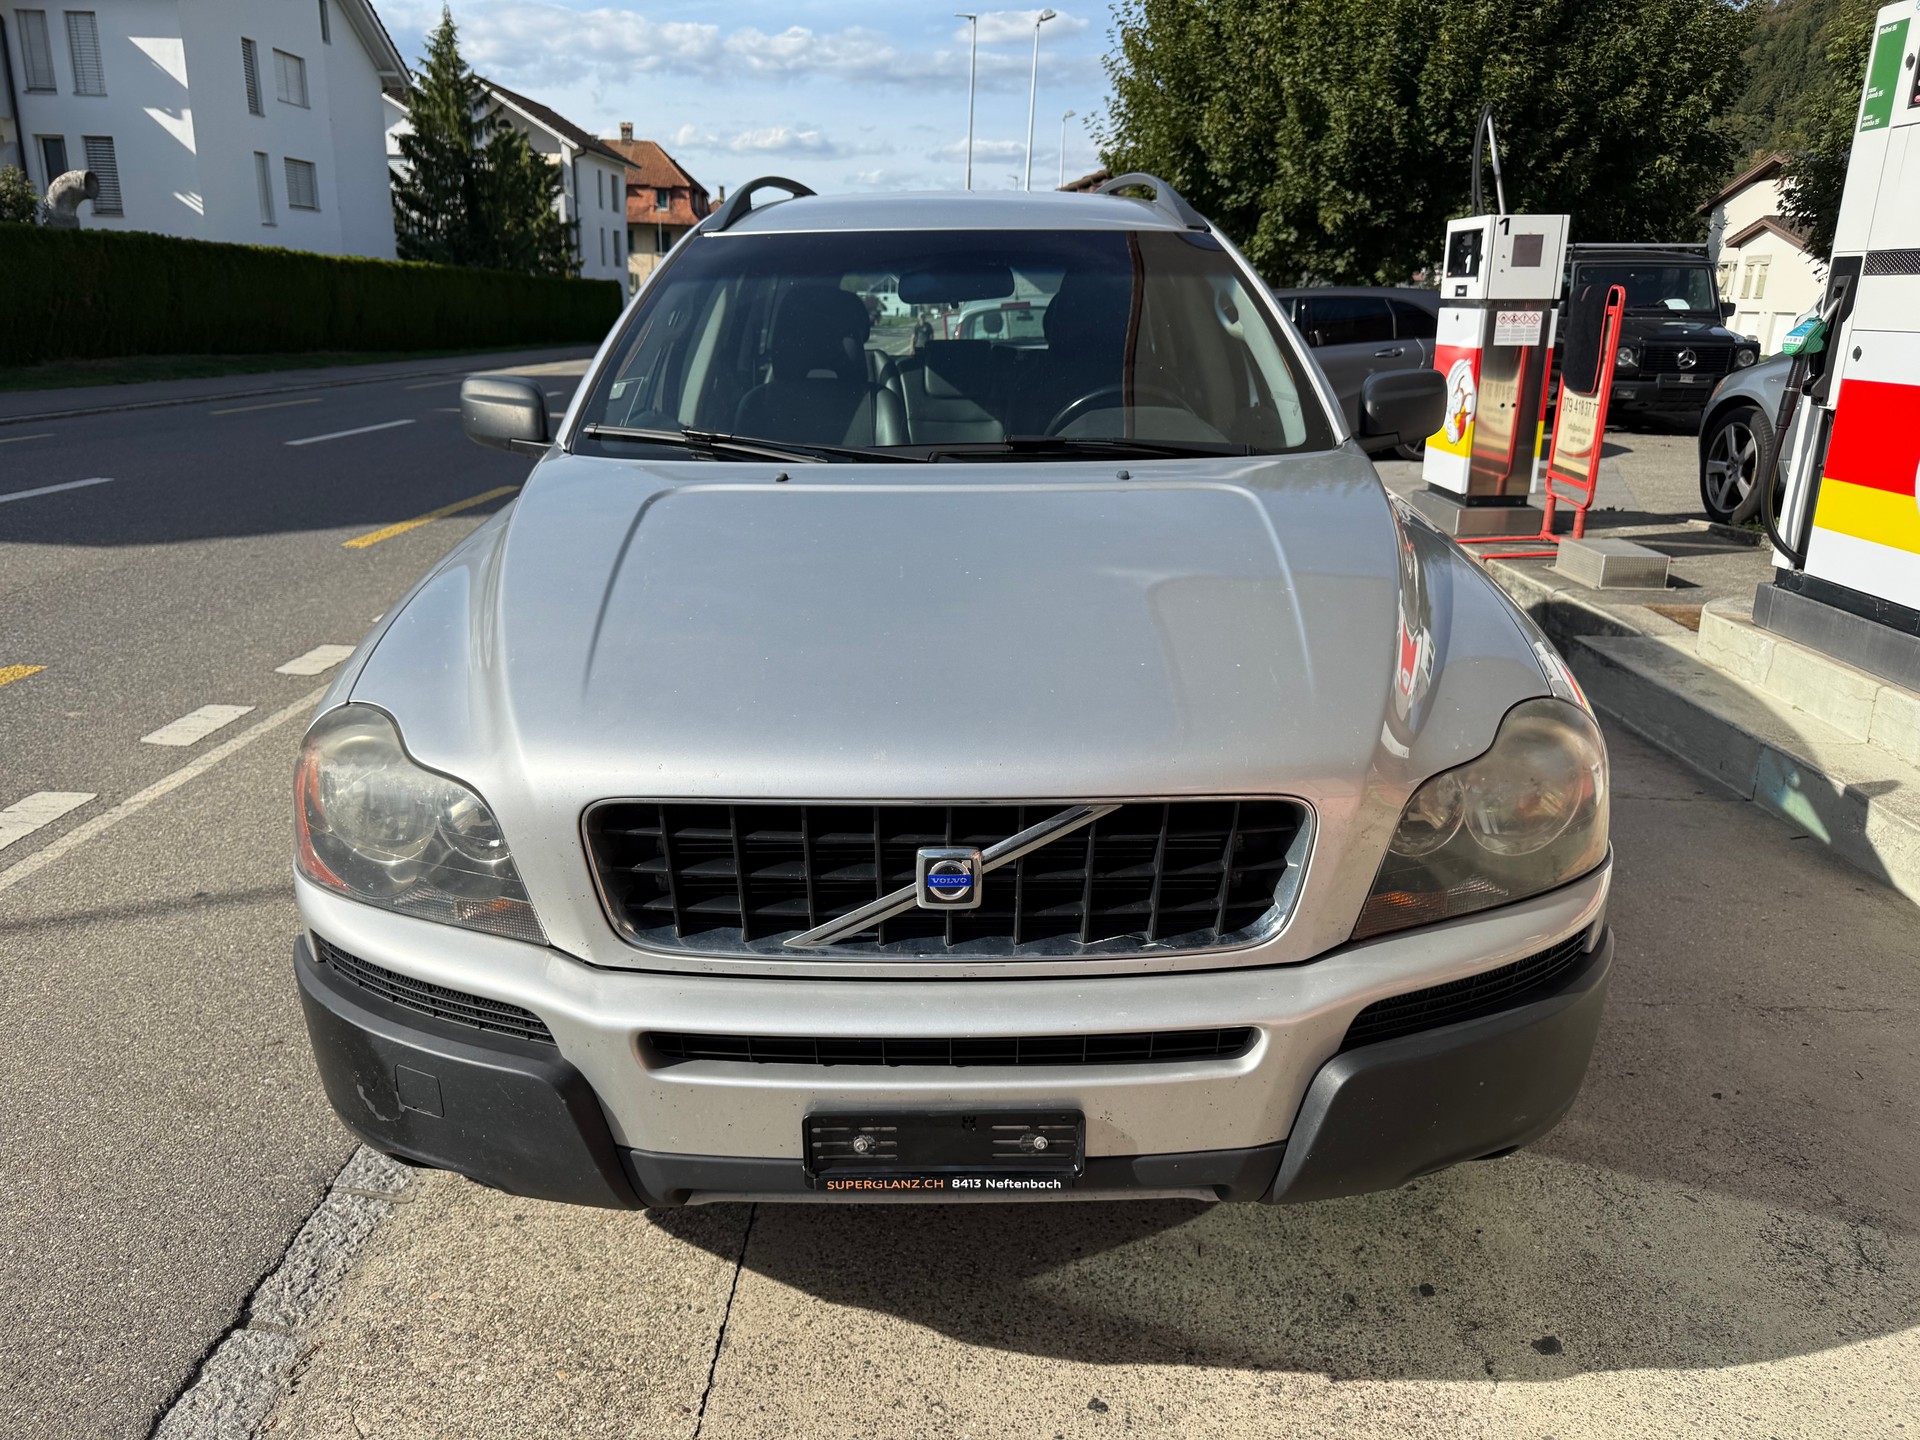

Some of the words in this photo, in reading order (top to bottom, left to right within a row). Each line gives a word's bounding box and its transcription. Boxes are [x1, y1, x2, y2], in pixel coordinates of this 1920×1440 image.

[1498, 218, 1511, 236] 1
[1465, 254, 1472, 274] 1
[826, 1179, 944, 1190] SUPERGLANZ.CH
[951, 1178, 982, 1189] 8413
[985, 1178, 1062, 1189] Neftenbach
